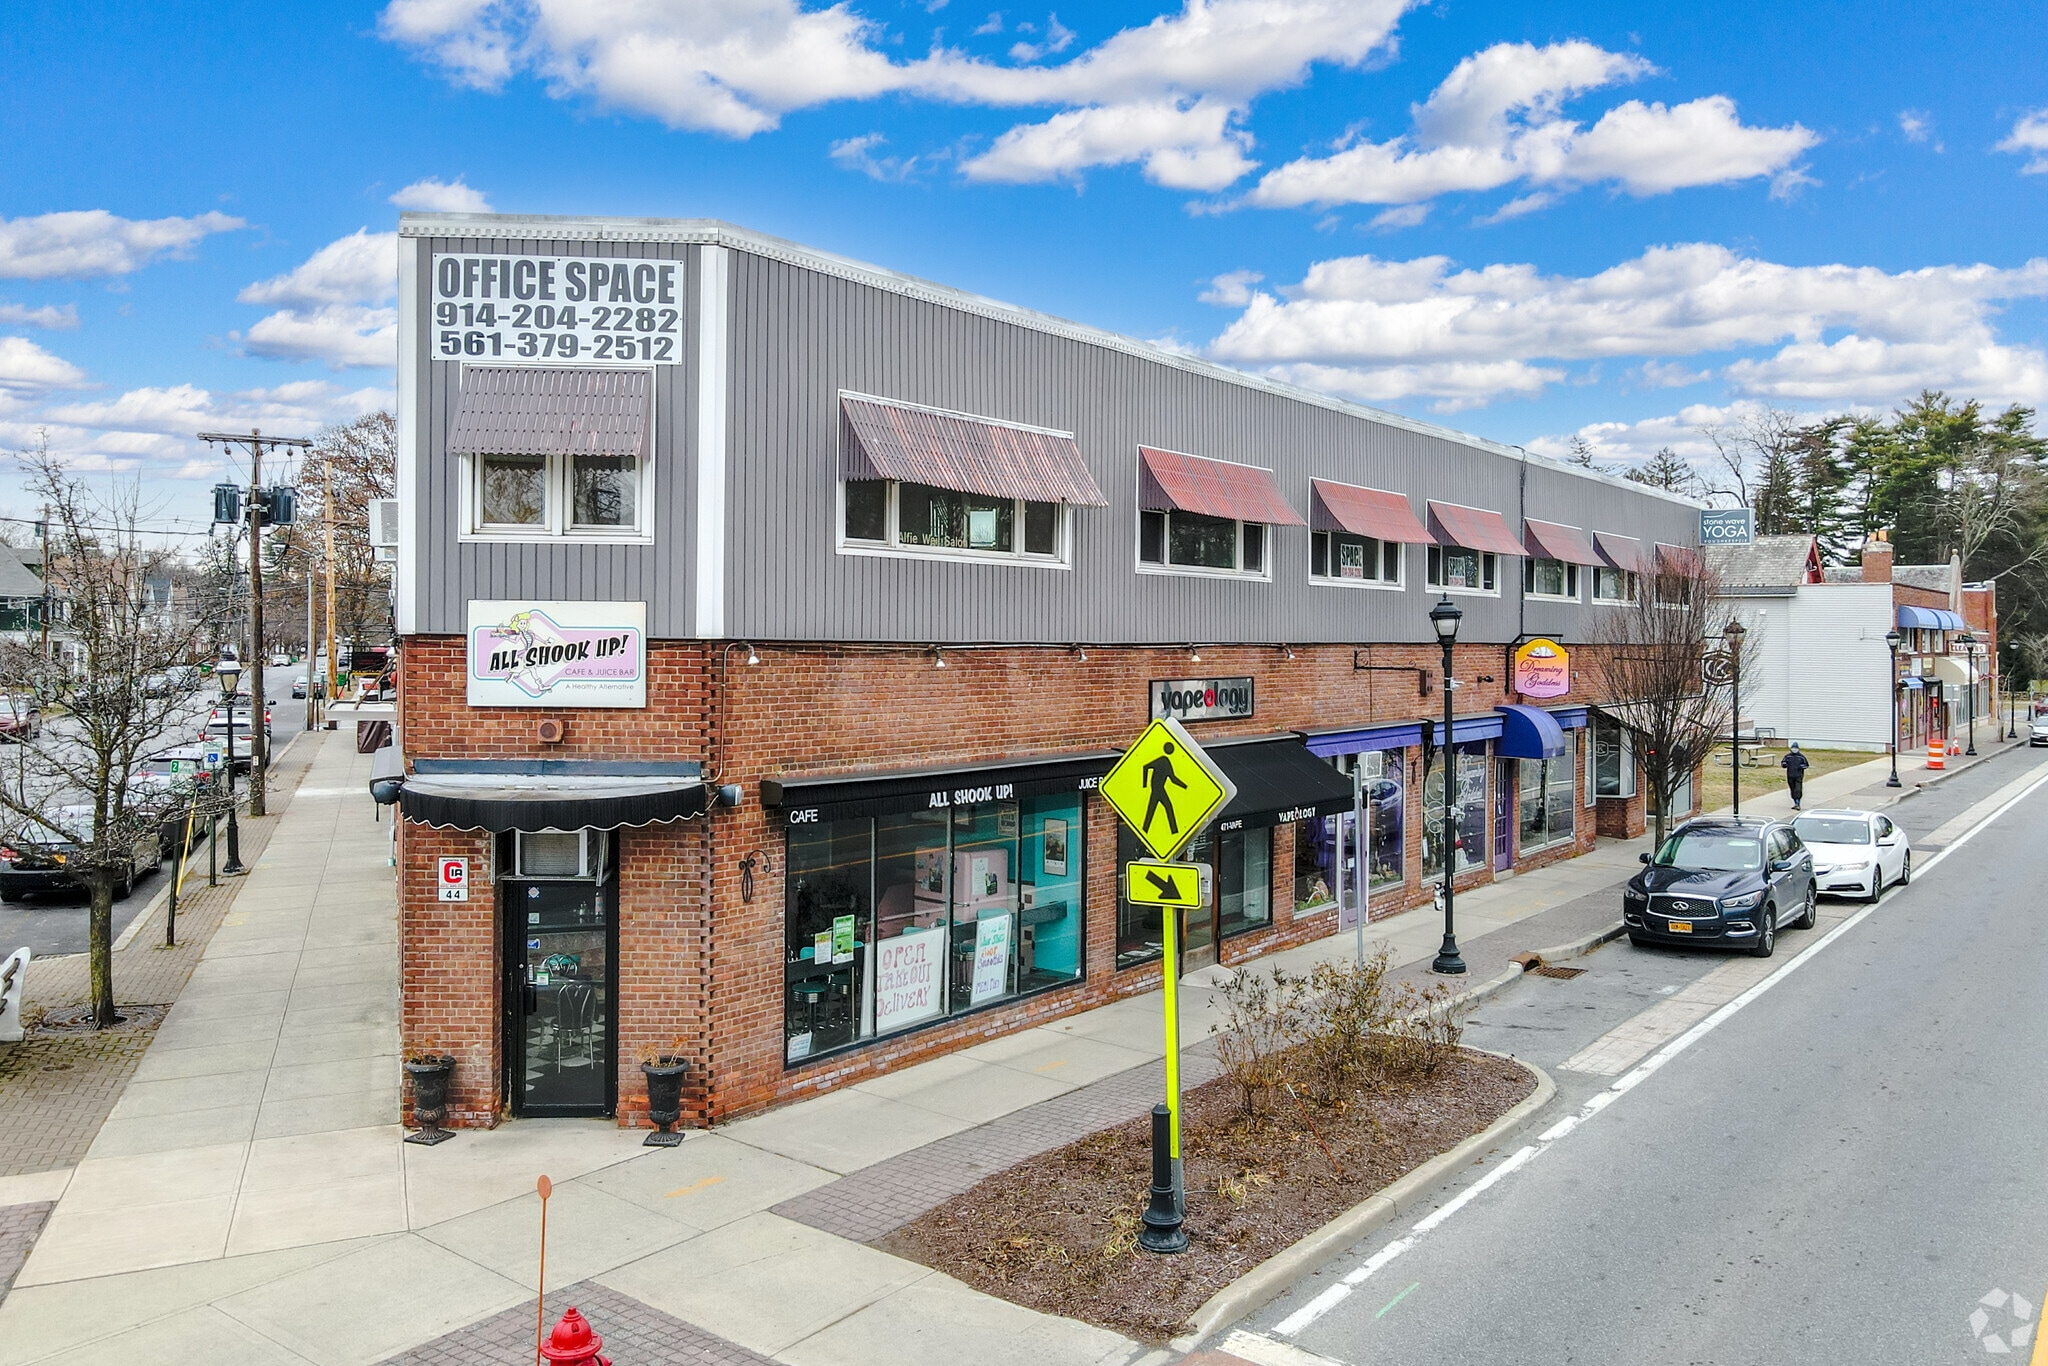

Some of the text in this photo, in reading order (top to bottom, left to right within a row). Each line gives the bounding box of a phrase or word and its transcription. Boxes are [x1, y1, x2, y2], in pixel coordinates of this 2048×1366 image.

[438, 257, 676, 304] OFFICE SPACE
[436, 301, 678, 333] 914-204-2282
[440, 330, 674, 361] 561-379-2512
[1702, 525, 1748, 538] YOGA
[490, 634, 629, 671] ALL SHOOK UP!
[565, 668, 635, 676] CAFE & JUICE BAR
[1519, 659, 1563, 676] Dreaming
[572, 683, 597, 691] Healthy
[1524, 672, 1561, 688] Goddess
[1161, 681, 1249, 717] vapeology
[172, 762, 178, 772] 2
[1078, 777, 1098, 790] JUICE
[928, 783, 1014, 808] ALL SHOOK UP!
[789, 808, 819, 824] CAFE
[1278, 806, 1316, 822] VAPEOLOGY
